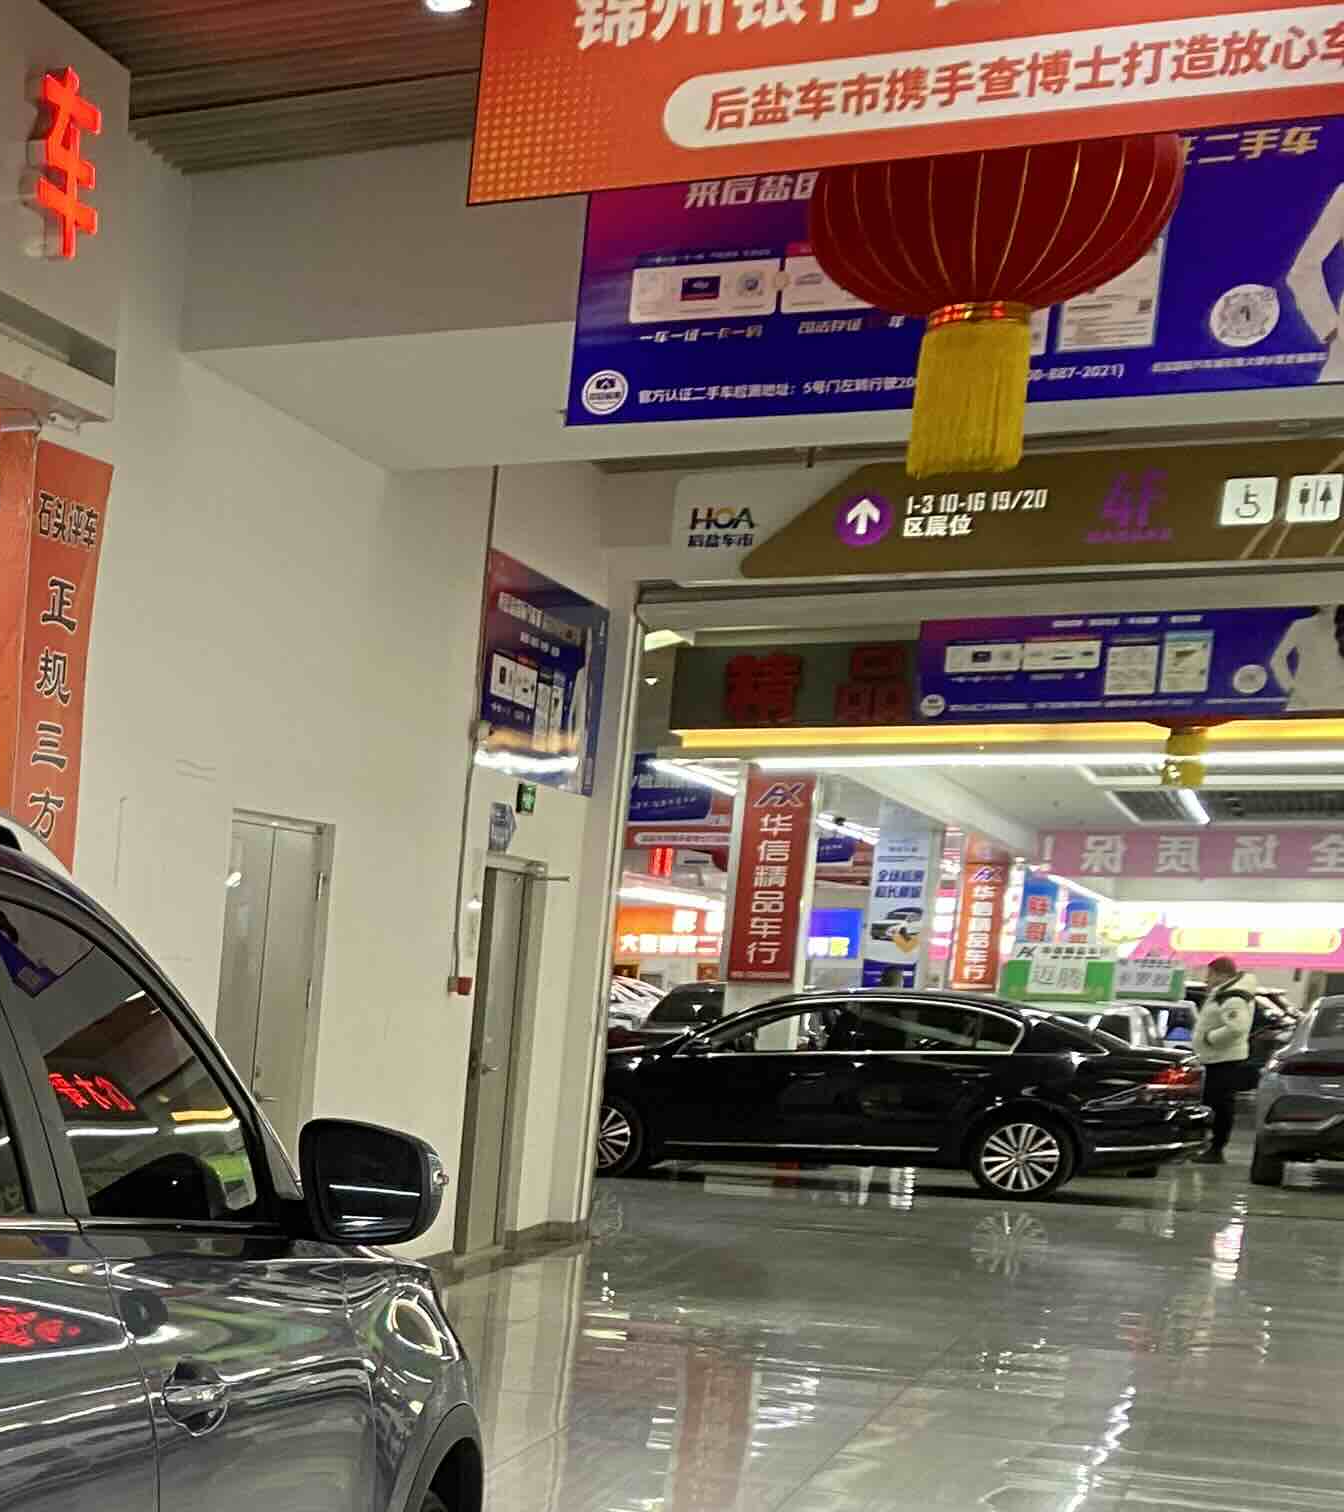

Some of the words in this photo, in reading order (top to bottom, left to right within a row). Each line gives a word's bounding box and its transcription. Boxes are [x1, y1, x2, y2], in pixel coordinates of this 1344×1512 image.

[37, 489, 99, 549] 石头评车
[690, 506, 755, 531] HOA
[903, 517, 973, 537] 区展位
[905, 496, 935, 516] 1-3
[938, 493, 986, 513] 10-16
[991, 488, 1049, 510] 19/20
[27, 576, 79, 841] 正规三方
[723, 645, 908, 726] 精品
[746, 813, 794, 965] 华信精品车行
